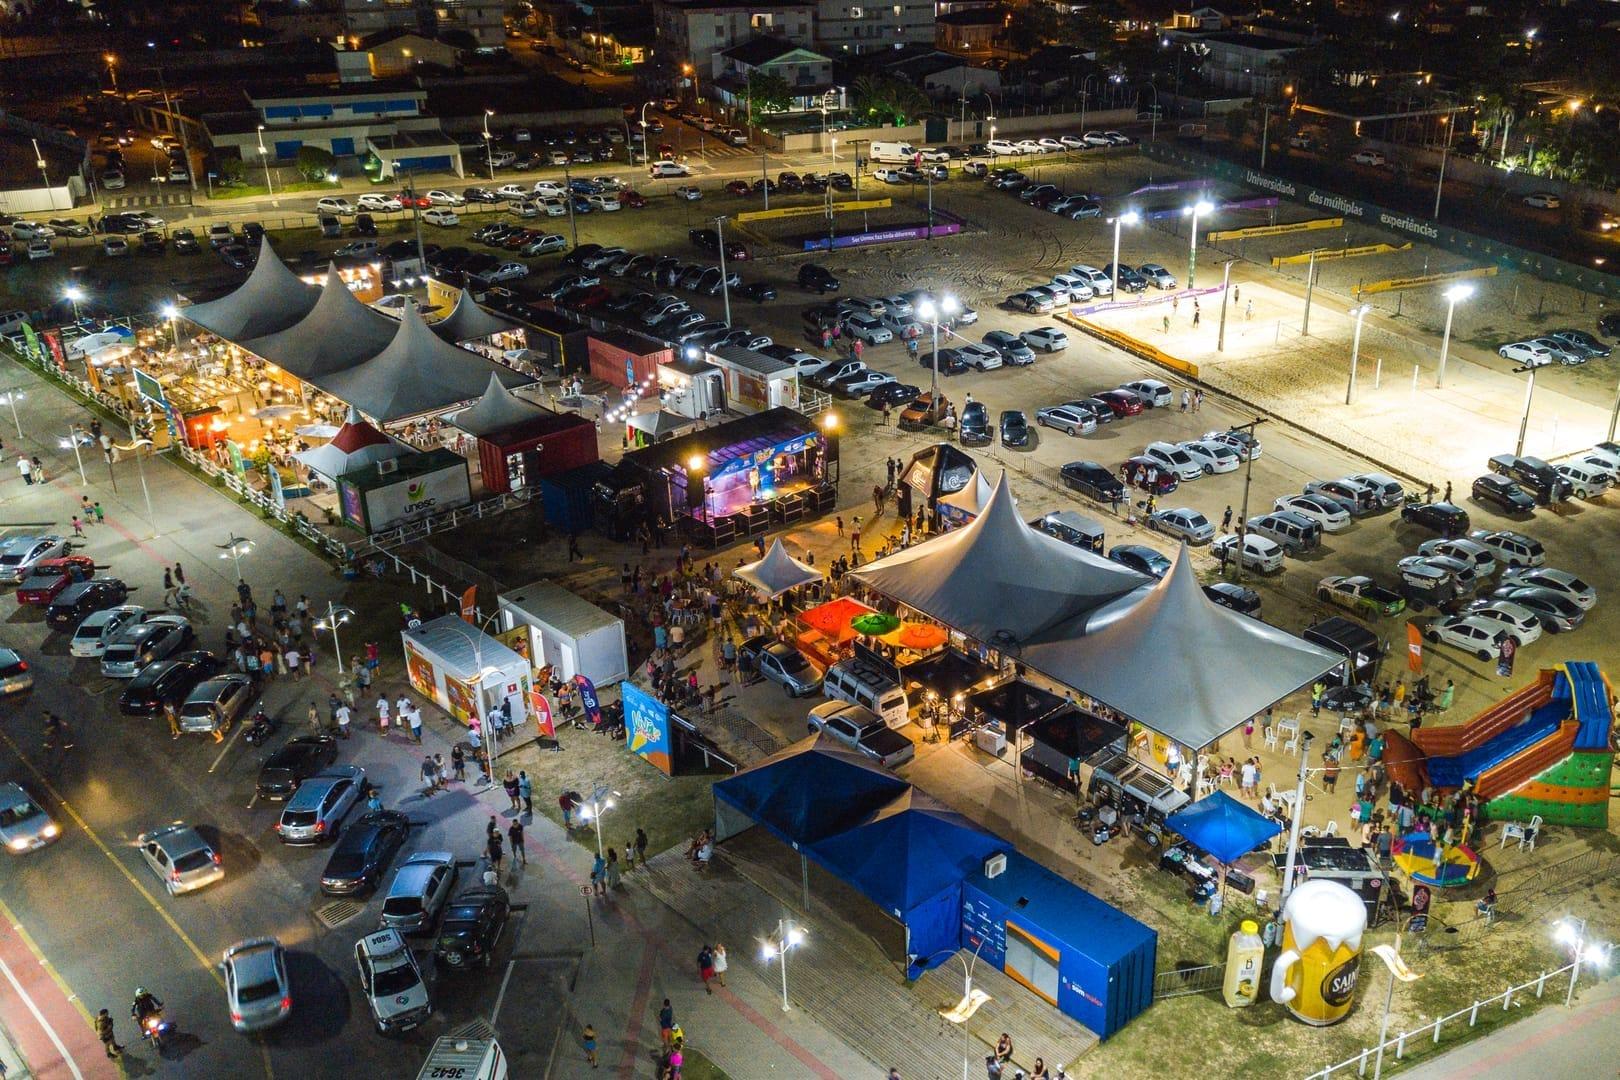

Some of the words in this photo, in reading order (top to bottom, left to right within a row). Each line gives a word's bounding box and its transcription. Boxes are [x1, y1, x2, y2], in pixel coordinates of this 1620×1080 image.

[1247, 170, 1296, 196] Universidade
[1308, 190, 1323, 206] das
[1323, 196, 1364, 217] múltiplas
[1380, 213, 1437, 239] experiências
[403, 498, 437, 513] unesc
[371, 932, 392, 945] 5804
[431, 1066, 465, 1079] 3642
